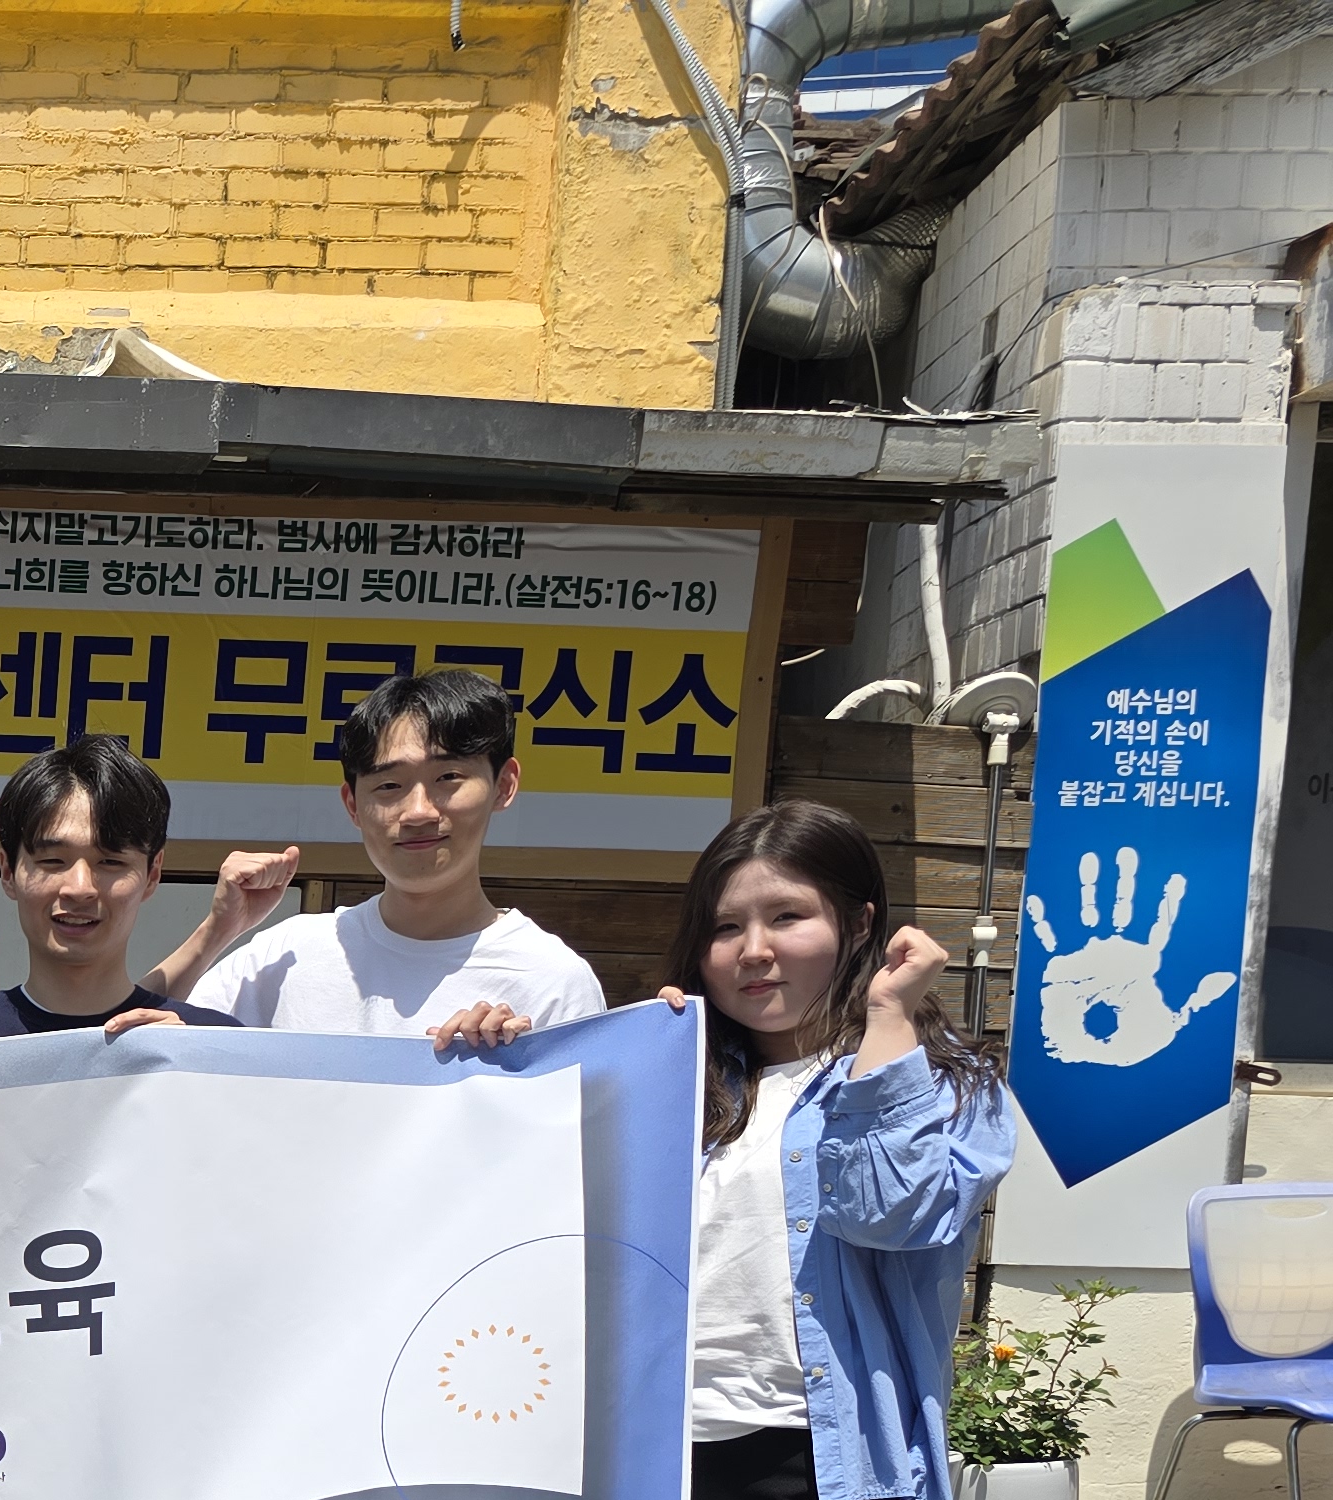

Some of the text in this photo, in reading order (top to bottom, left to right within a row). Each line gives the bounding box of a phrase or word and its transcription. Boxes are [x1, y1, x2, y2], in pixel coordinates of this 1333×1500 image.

[276, 518, 378, 556] 범사에
[389, 521, 526, 561] 감사하라
[102, 559, 203, 598] 향하신
[213, 564, 349, 603] 하나님의
[359, 568, 718, 615] 뜻이니라.(살전5:16~18)
[206, 639, 738, 775] 무료식소
[1106, 688, 1197, 715] 예수님의
[1090, 719, 1210, 746] 기적의 손이
[1114, 749, 1183, 777] 당신을
[1057, 780, 1231, 808] 붙잡고 계십니다.
[1308, 772, 1333, 804] 이
